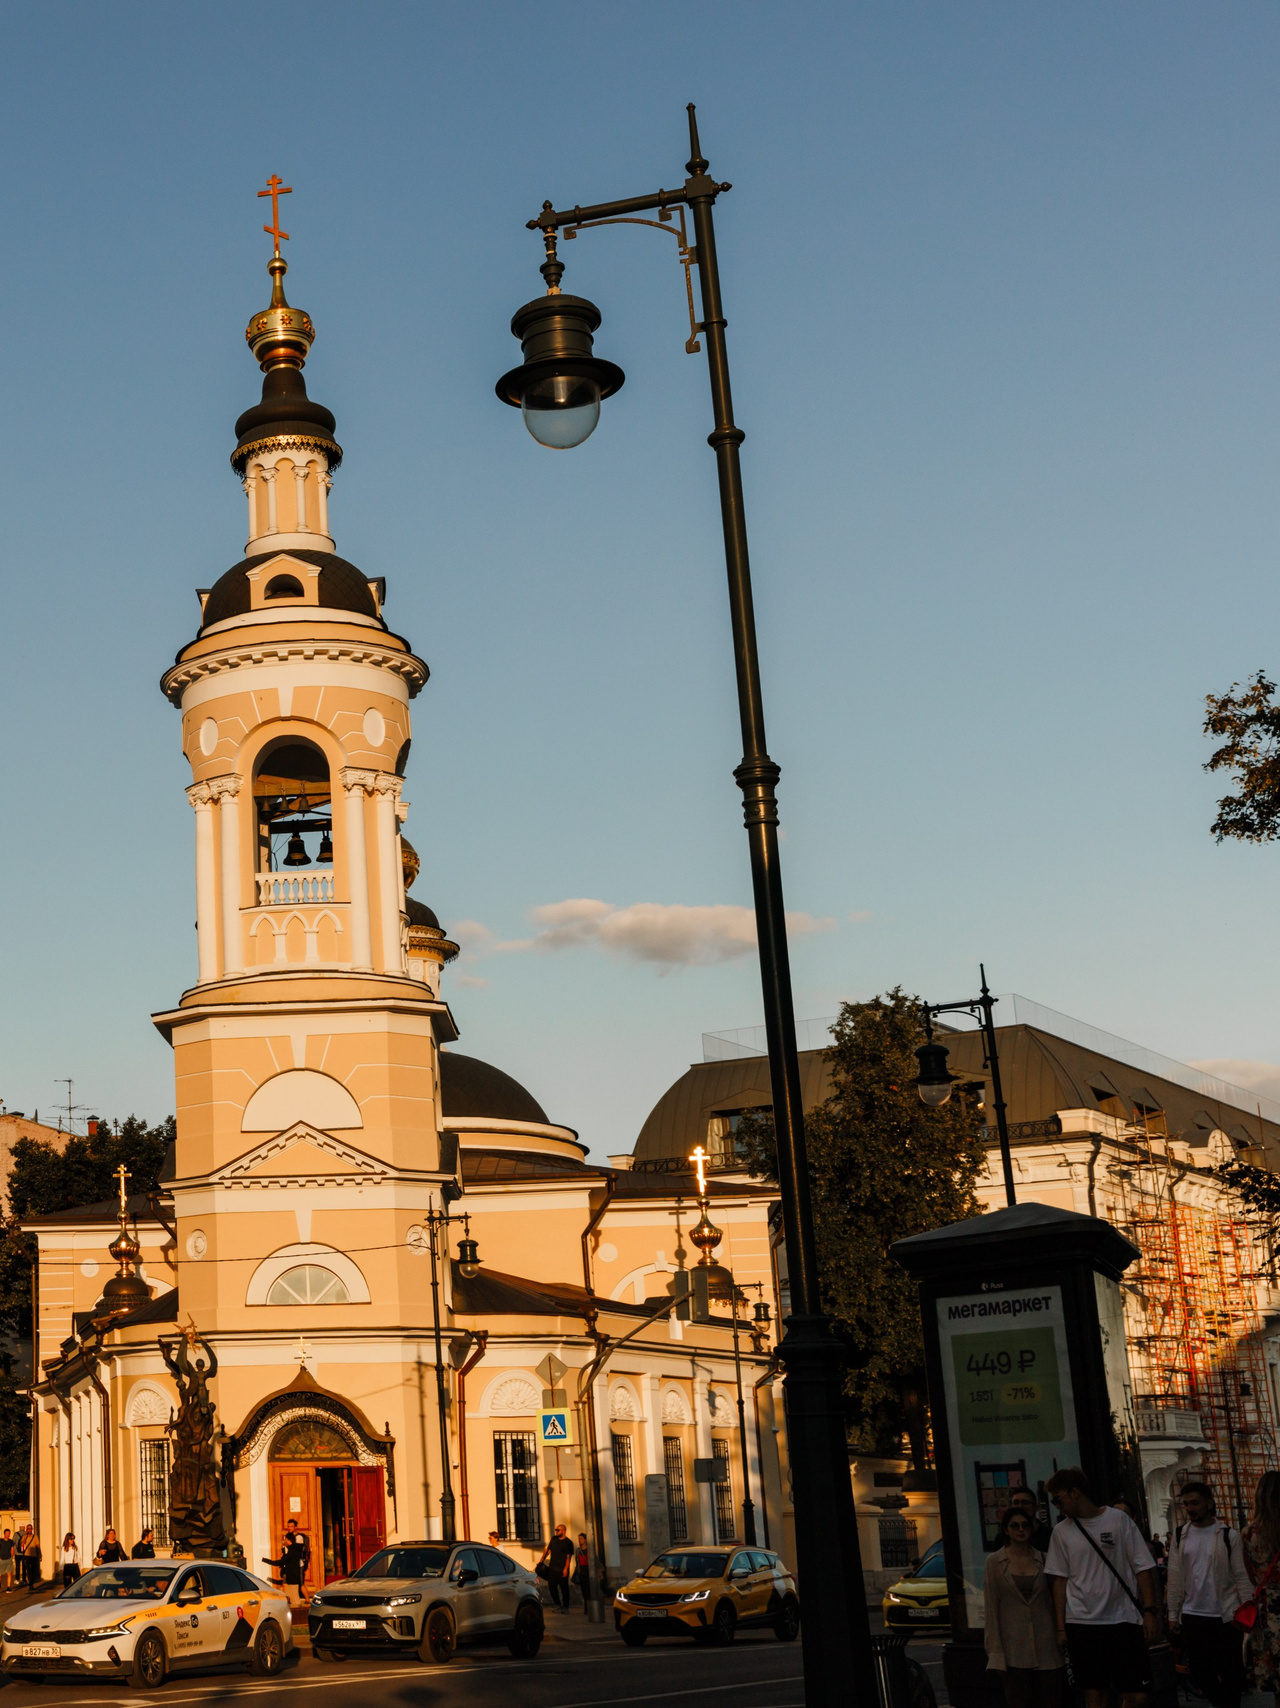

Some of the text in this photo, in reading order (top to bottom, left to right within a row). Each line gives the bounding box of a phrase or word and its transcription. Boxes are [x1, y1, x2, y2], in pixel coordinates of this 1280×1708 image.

[948, 1296, 1051, 1320] мегамаркет
[966, 1351, 1011, 1376] 449
[1007, 1386, 1035, 1400] -71%
